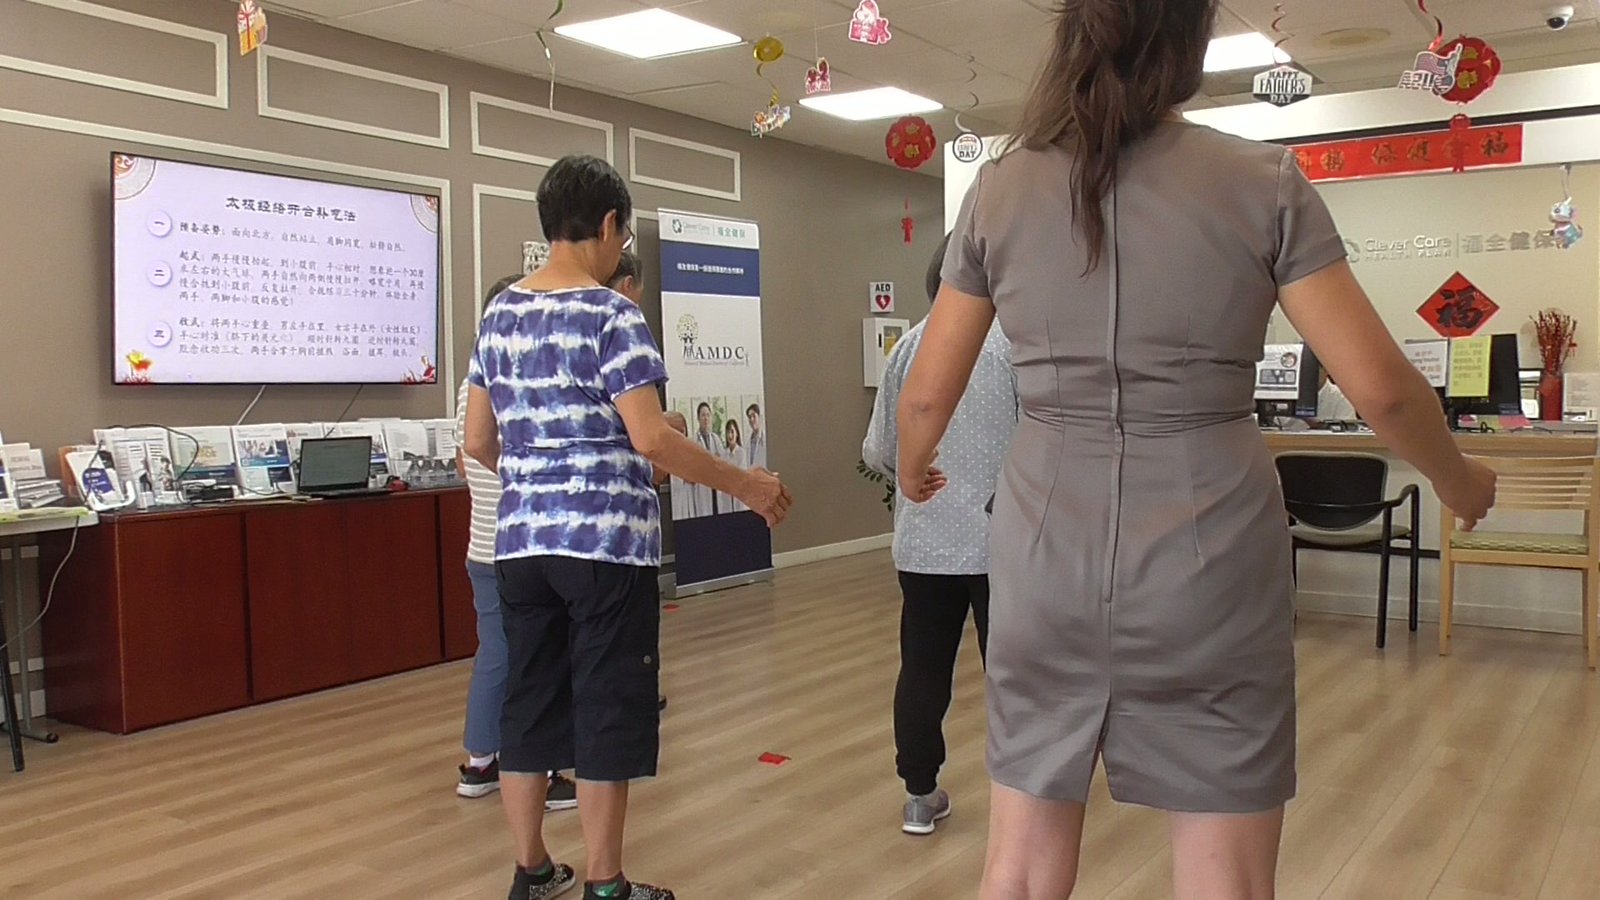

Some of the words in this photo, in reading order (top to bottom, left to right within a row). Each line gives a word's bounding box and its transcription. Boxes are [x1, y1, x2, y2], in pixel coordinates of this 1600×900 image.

[1269, 71, 1299, 79] HAPPY
[1269, 94, 1294, 104] DAY
[959, 150, 976, 158] DAY
[1364, 238, 1410, 251] Clever
[1412, 234, 1452, 250] Care
[875, 283, 891, 292] AED
[1435, 285, 1485, 331] 福
[695, 345, 745, 360] AMDC
